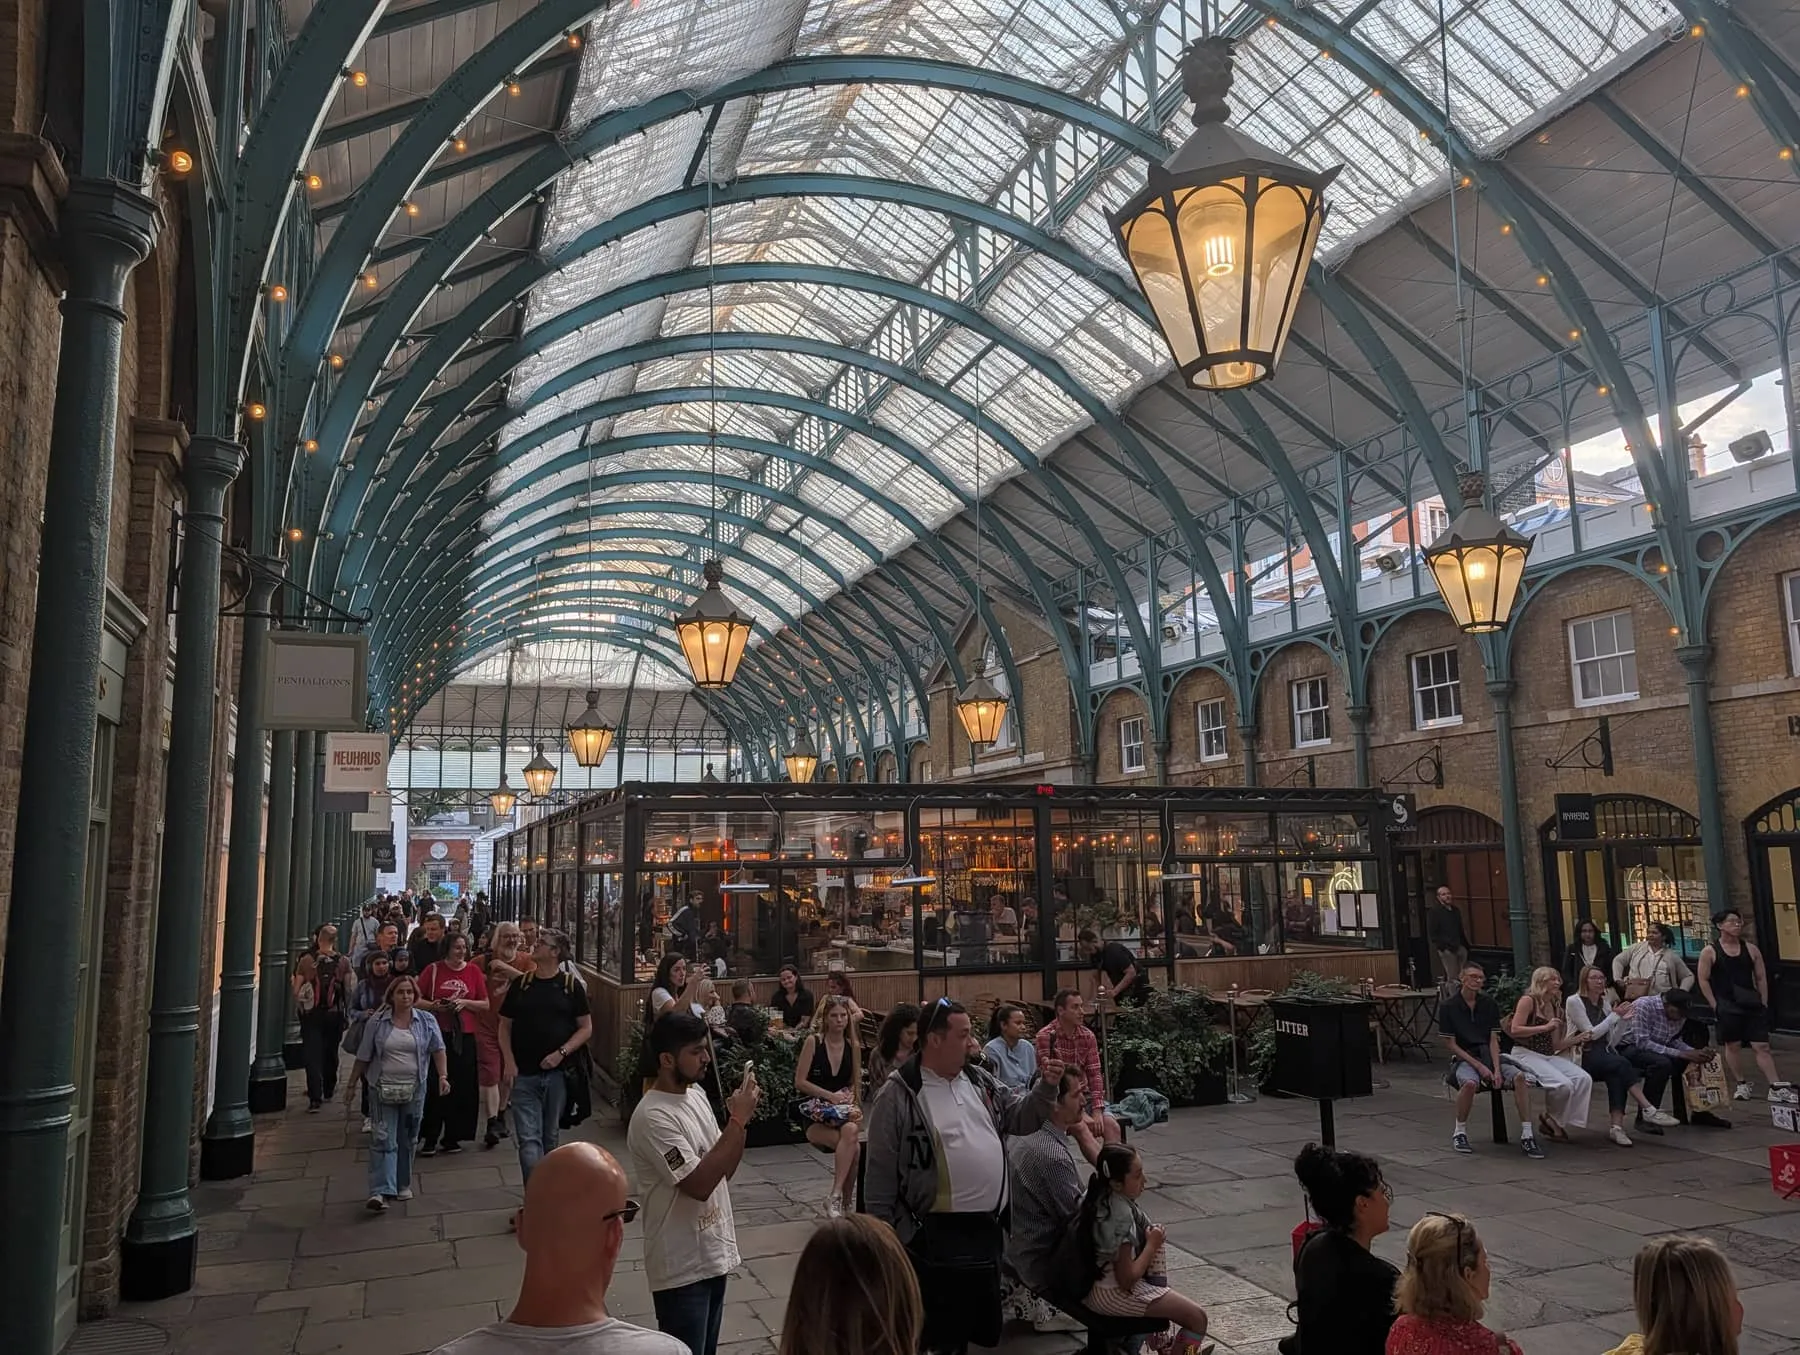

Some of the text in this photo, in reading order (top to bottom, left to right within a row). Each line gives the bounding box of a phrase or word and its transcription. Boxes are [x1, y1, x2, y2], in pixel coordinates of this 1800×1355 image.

[277, 676, 352, 687] PENHALIGON'S
[333, 750, 382, 766] NEUHAUS
[1275, 1019, 1309, 1037] LITTER
